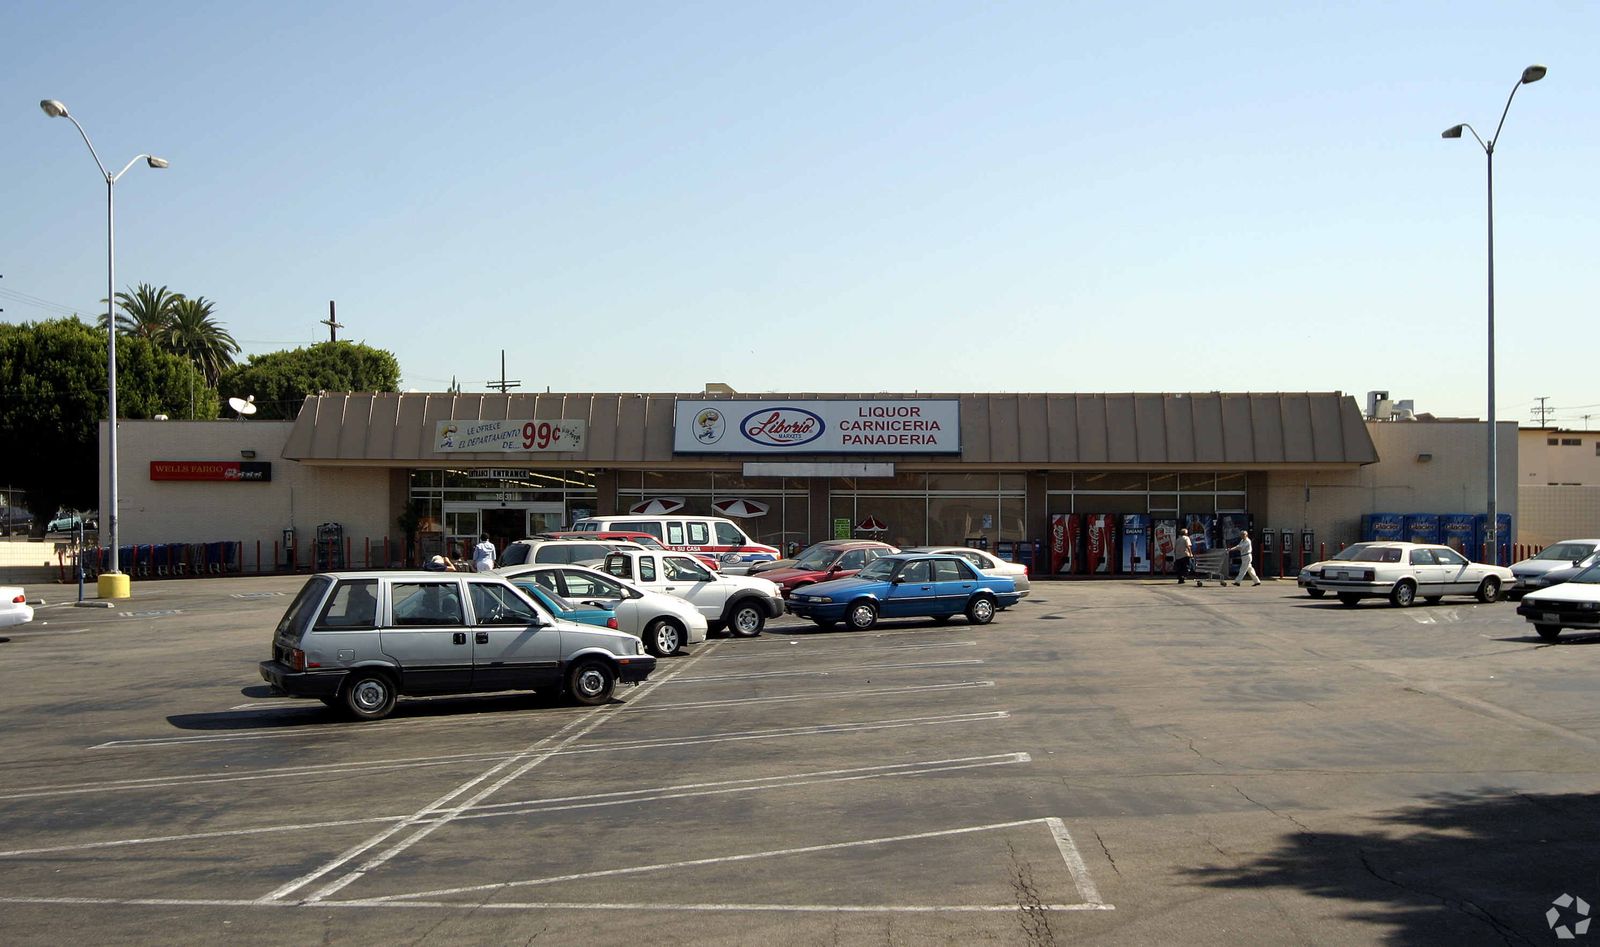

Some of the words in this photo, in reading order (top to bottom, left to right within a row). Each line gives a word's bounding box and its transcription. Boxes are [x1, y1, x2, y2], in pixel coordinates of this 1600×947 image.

[859, 406, 921, 418] LIQUOR
[476, 422, 501, 433] OFRECE
[749, 412, 815, 443] Liborio
[840, 420, 941, 431] CARNICERIA
[467, 428, 521, 447] DEPARTAMENTO
[842, 434, 938, 445] PANADERIA
[155, 465, 189, 473] WELLS
[190, 465, 224, 473] FARGO
[492, 470, 527, 478] ENTRANCE
